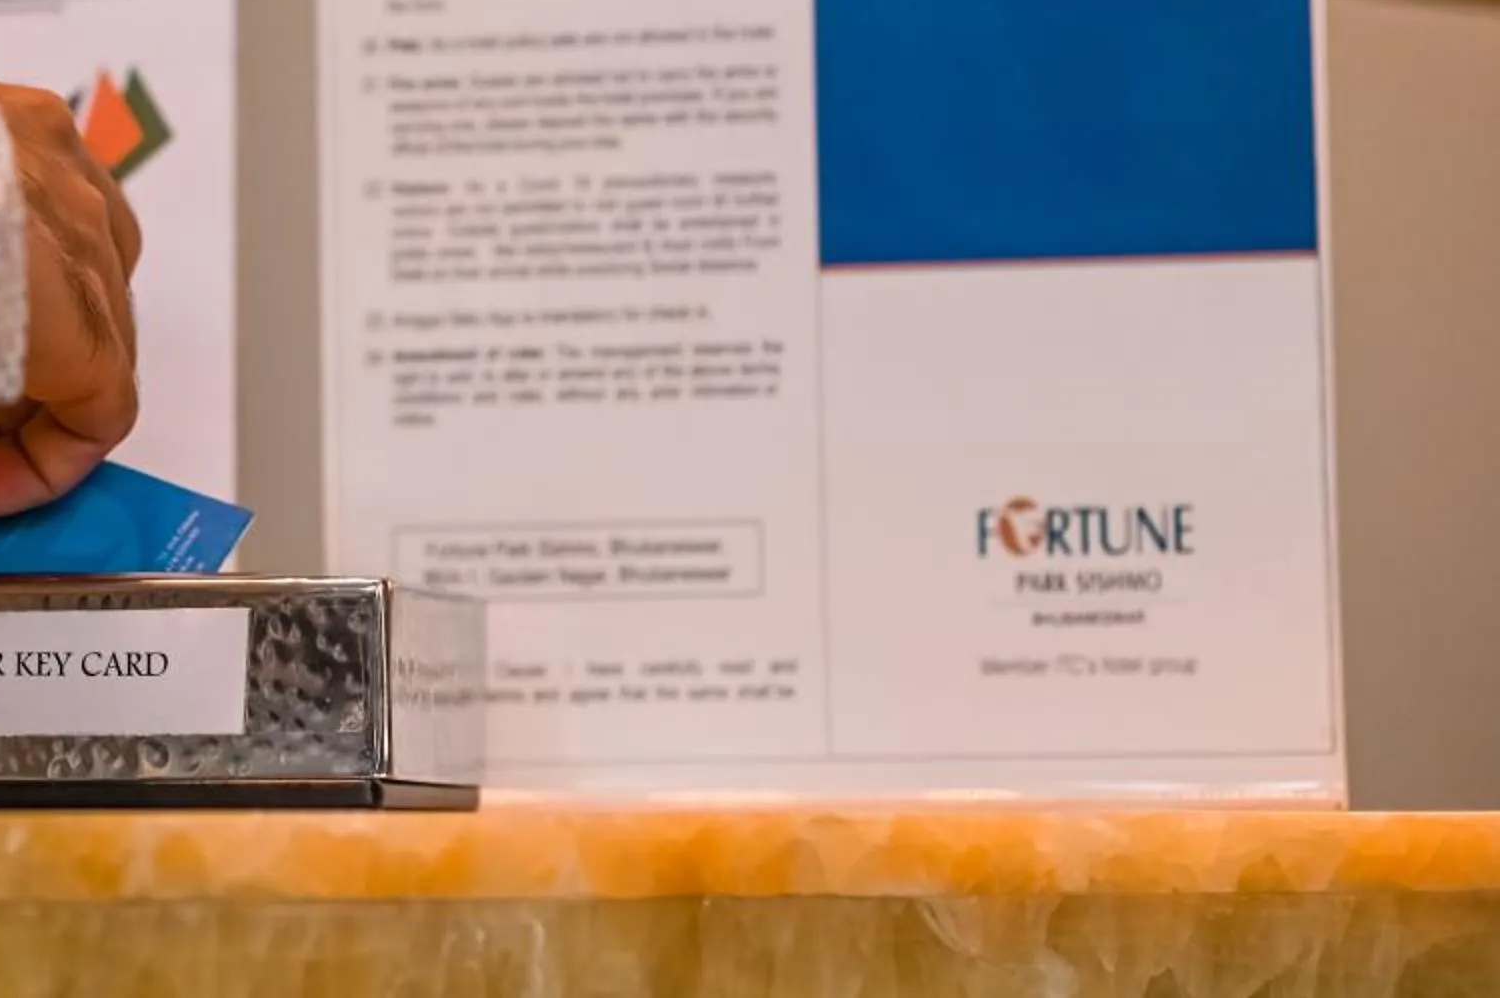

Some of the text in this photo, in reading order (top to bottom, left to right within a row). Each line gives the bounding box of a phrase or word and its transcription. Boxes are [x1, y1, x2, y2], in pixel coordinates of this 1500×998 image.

[976, 494, 1196, 558] FORTUNE
[1015, 570, 1067, 593] PARK
[14, 650, 73, 677] KEY
[80, 650, 169, 677] CARD
